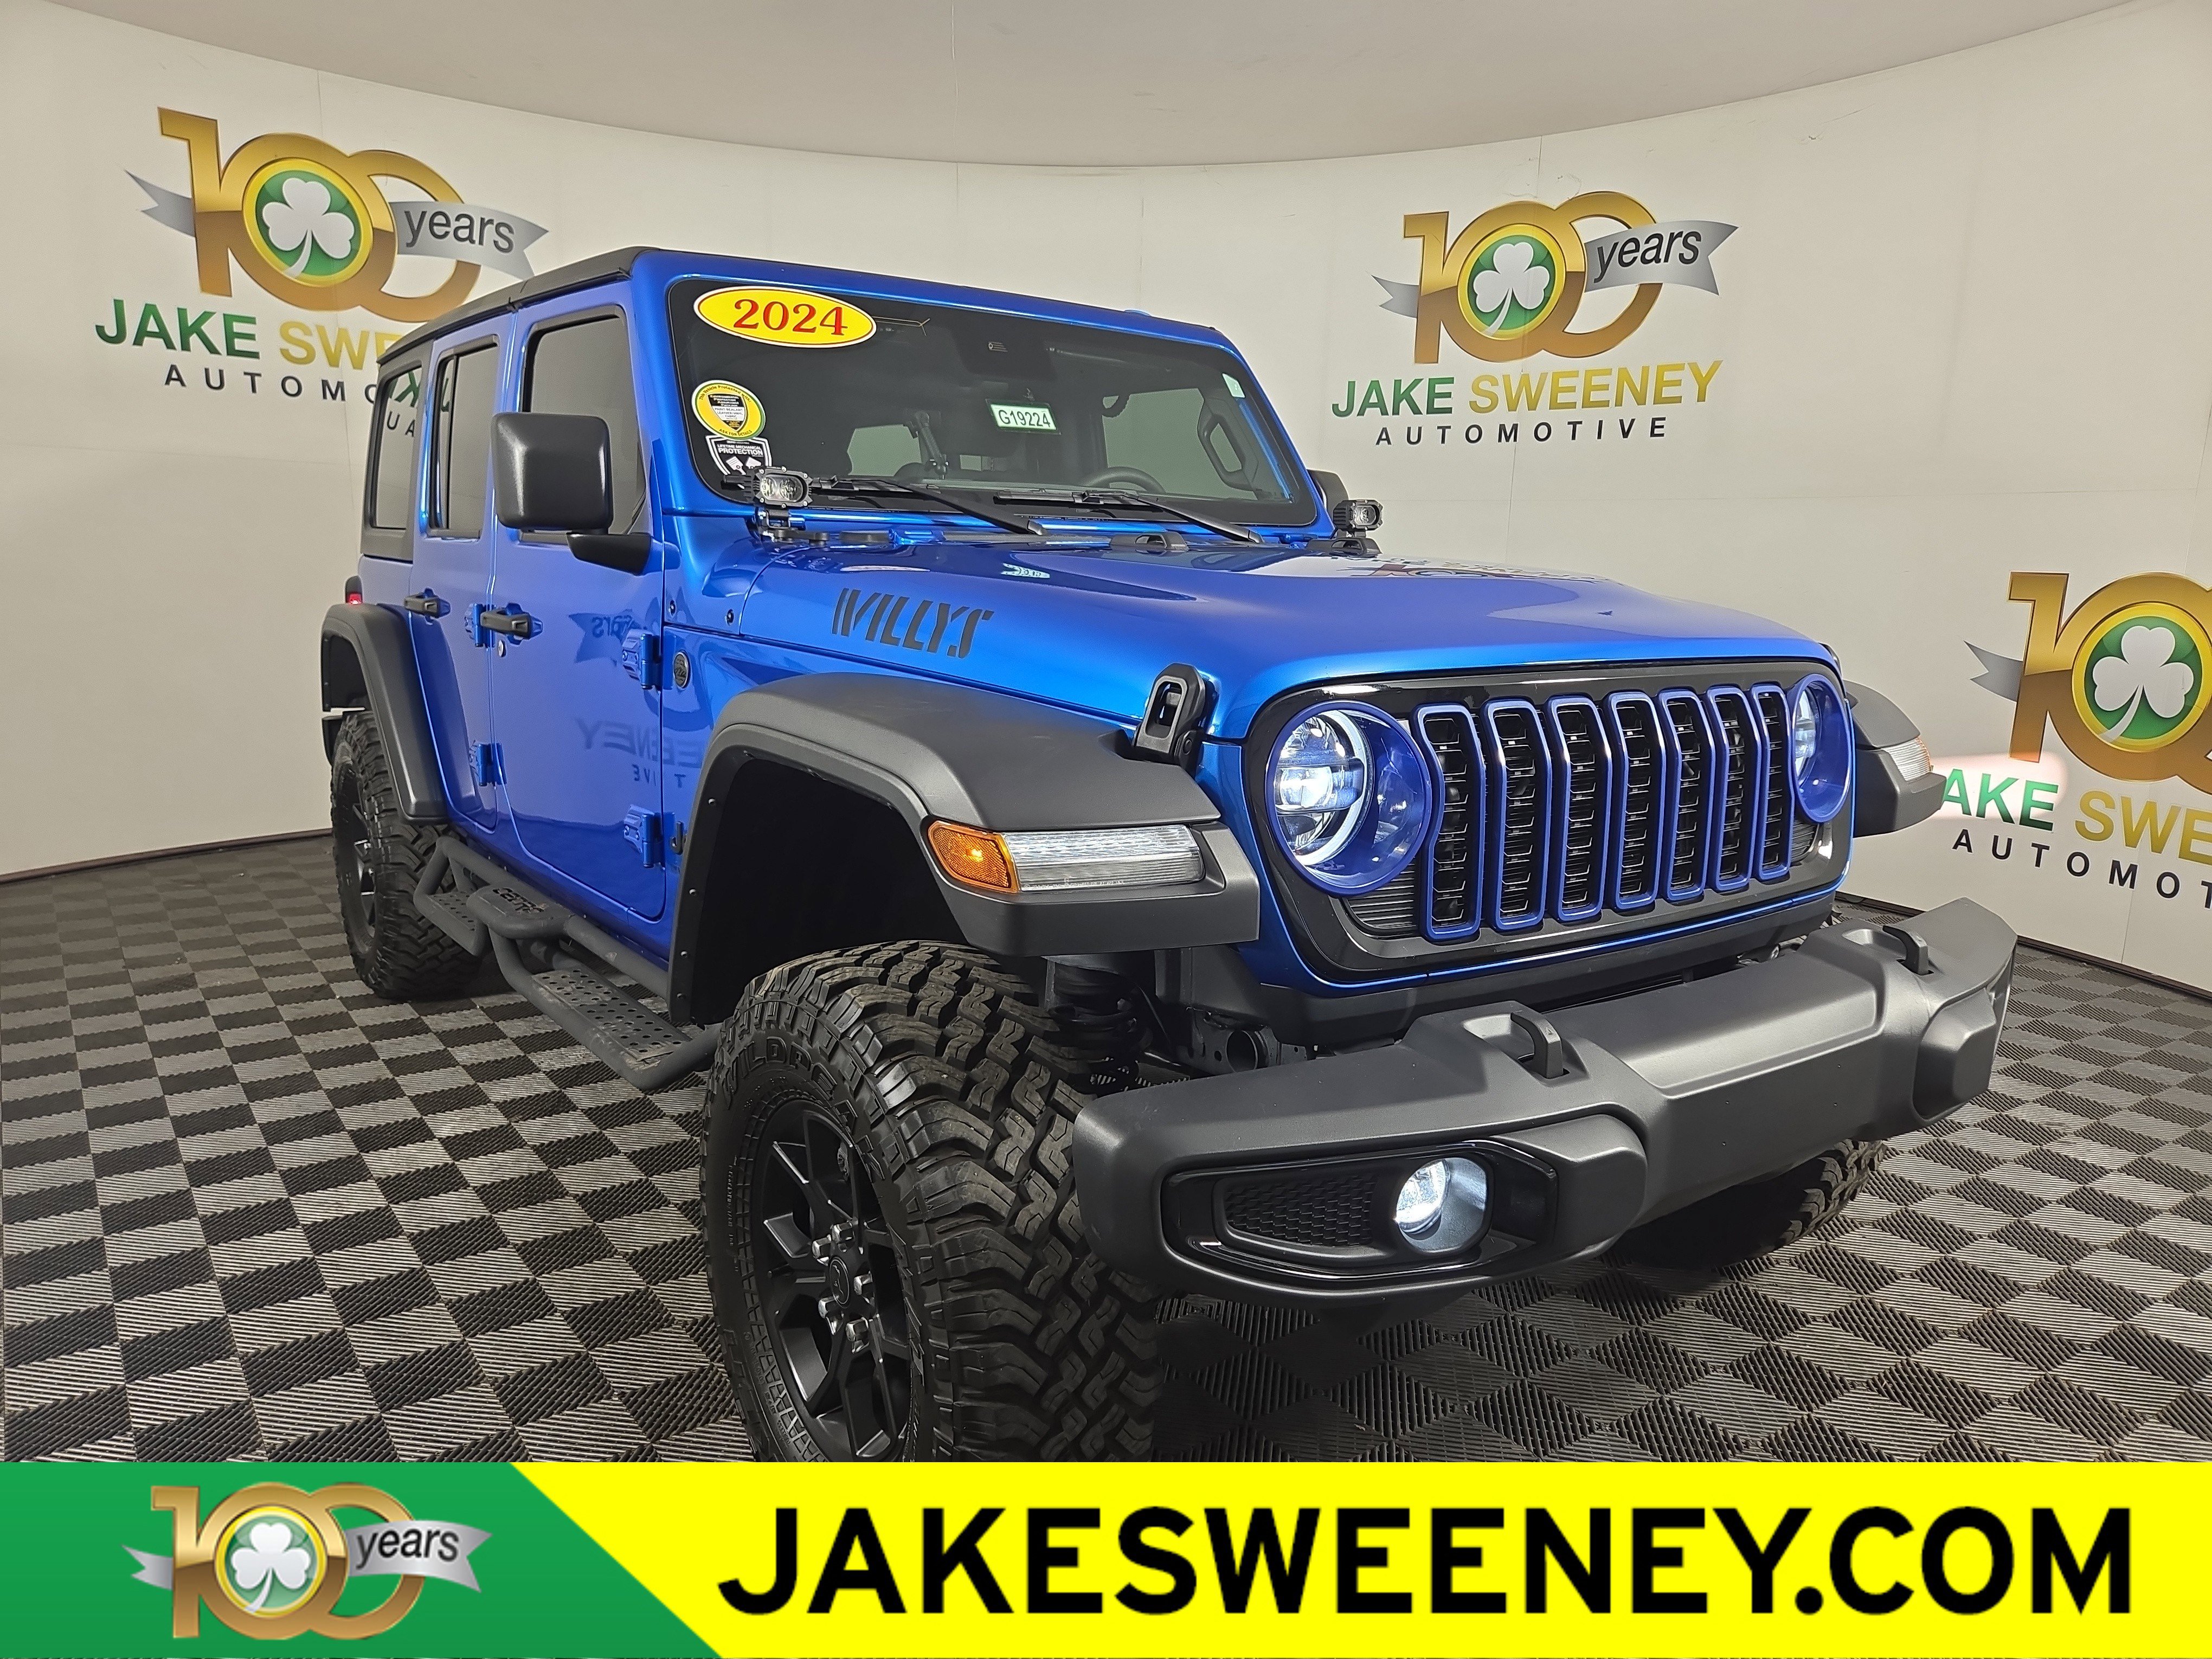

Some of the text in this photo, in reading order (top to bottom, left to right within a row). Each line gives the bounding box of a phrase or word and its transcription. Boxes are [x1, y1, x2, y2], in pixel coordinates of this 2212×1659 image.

[404, 208, 515, 254] years
[1594, 230, 1701, 282] years
[95, 299, 260, 359] JAKE
[733, 299, 848, 336] 2024
[718, 385, 741, 394] Protected
[1332, 360, 1723, 417] JAKE SWEENEY
[998, 409, 1051, 427] G19224
[1375, 416, 1667, 446] AUTOMOTIVE
[832, 588, 994, 659] WILLYS
[1942, 768, 2059, 832] AKE
